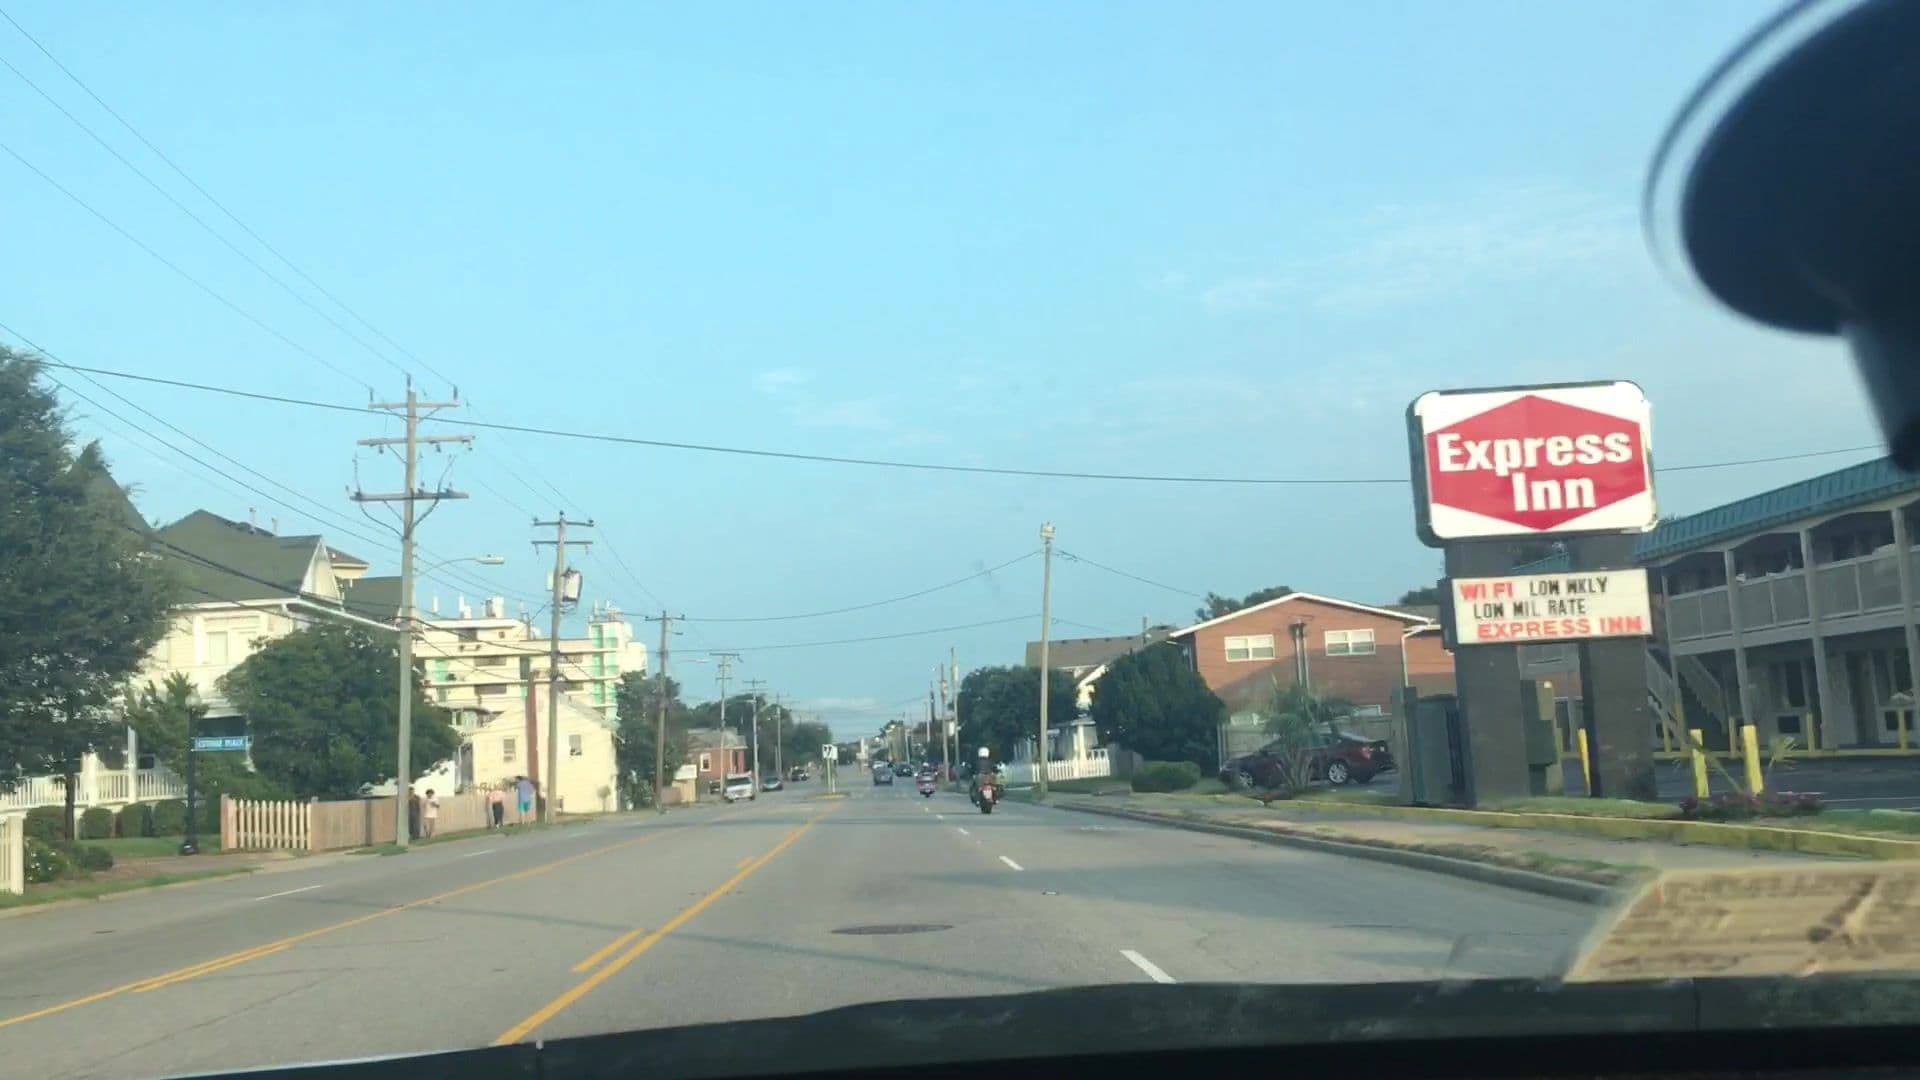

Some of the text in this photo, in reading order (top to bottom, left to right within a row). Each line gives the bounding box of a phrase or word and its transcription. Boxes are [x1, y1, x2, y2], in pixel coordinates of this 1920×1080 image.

[1437, 432, 1633, 476] Express
[1512, 472, 1597, 512] Inn
[1530, 580, 1560, 597] LOW
[1566, 576, 1608, 594] WKLY
[1473, 598, 1587, 619] LOW MIL RATE
[1477, 616, 1643, 640] EXPRESS INN
